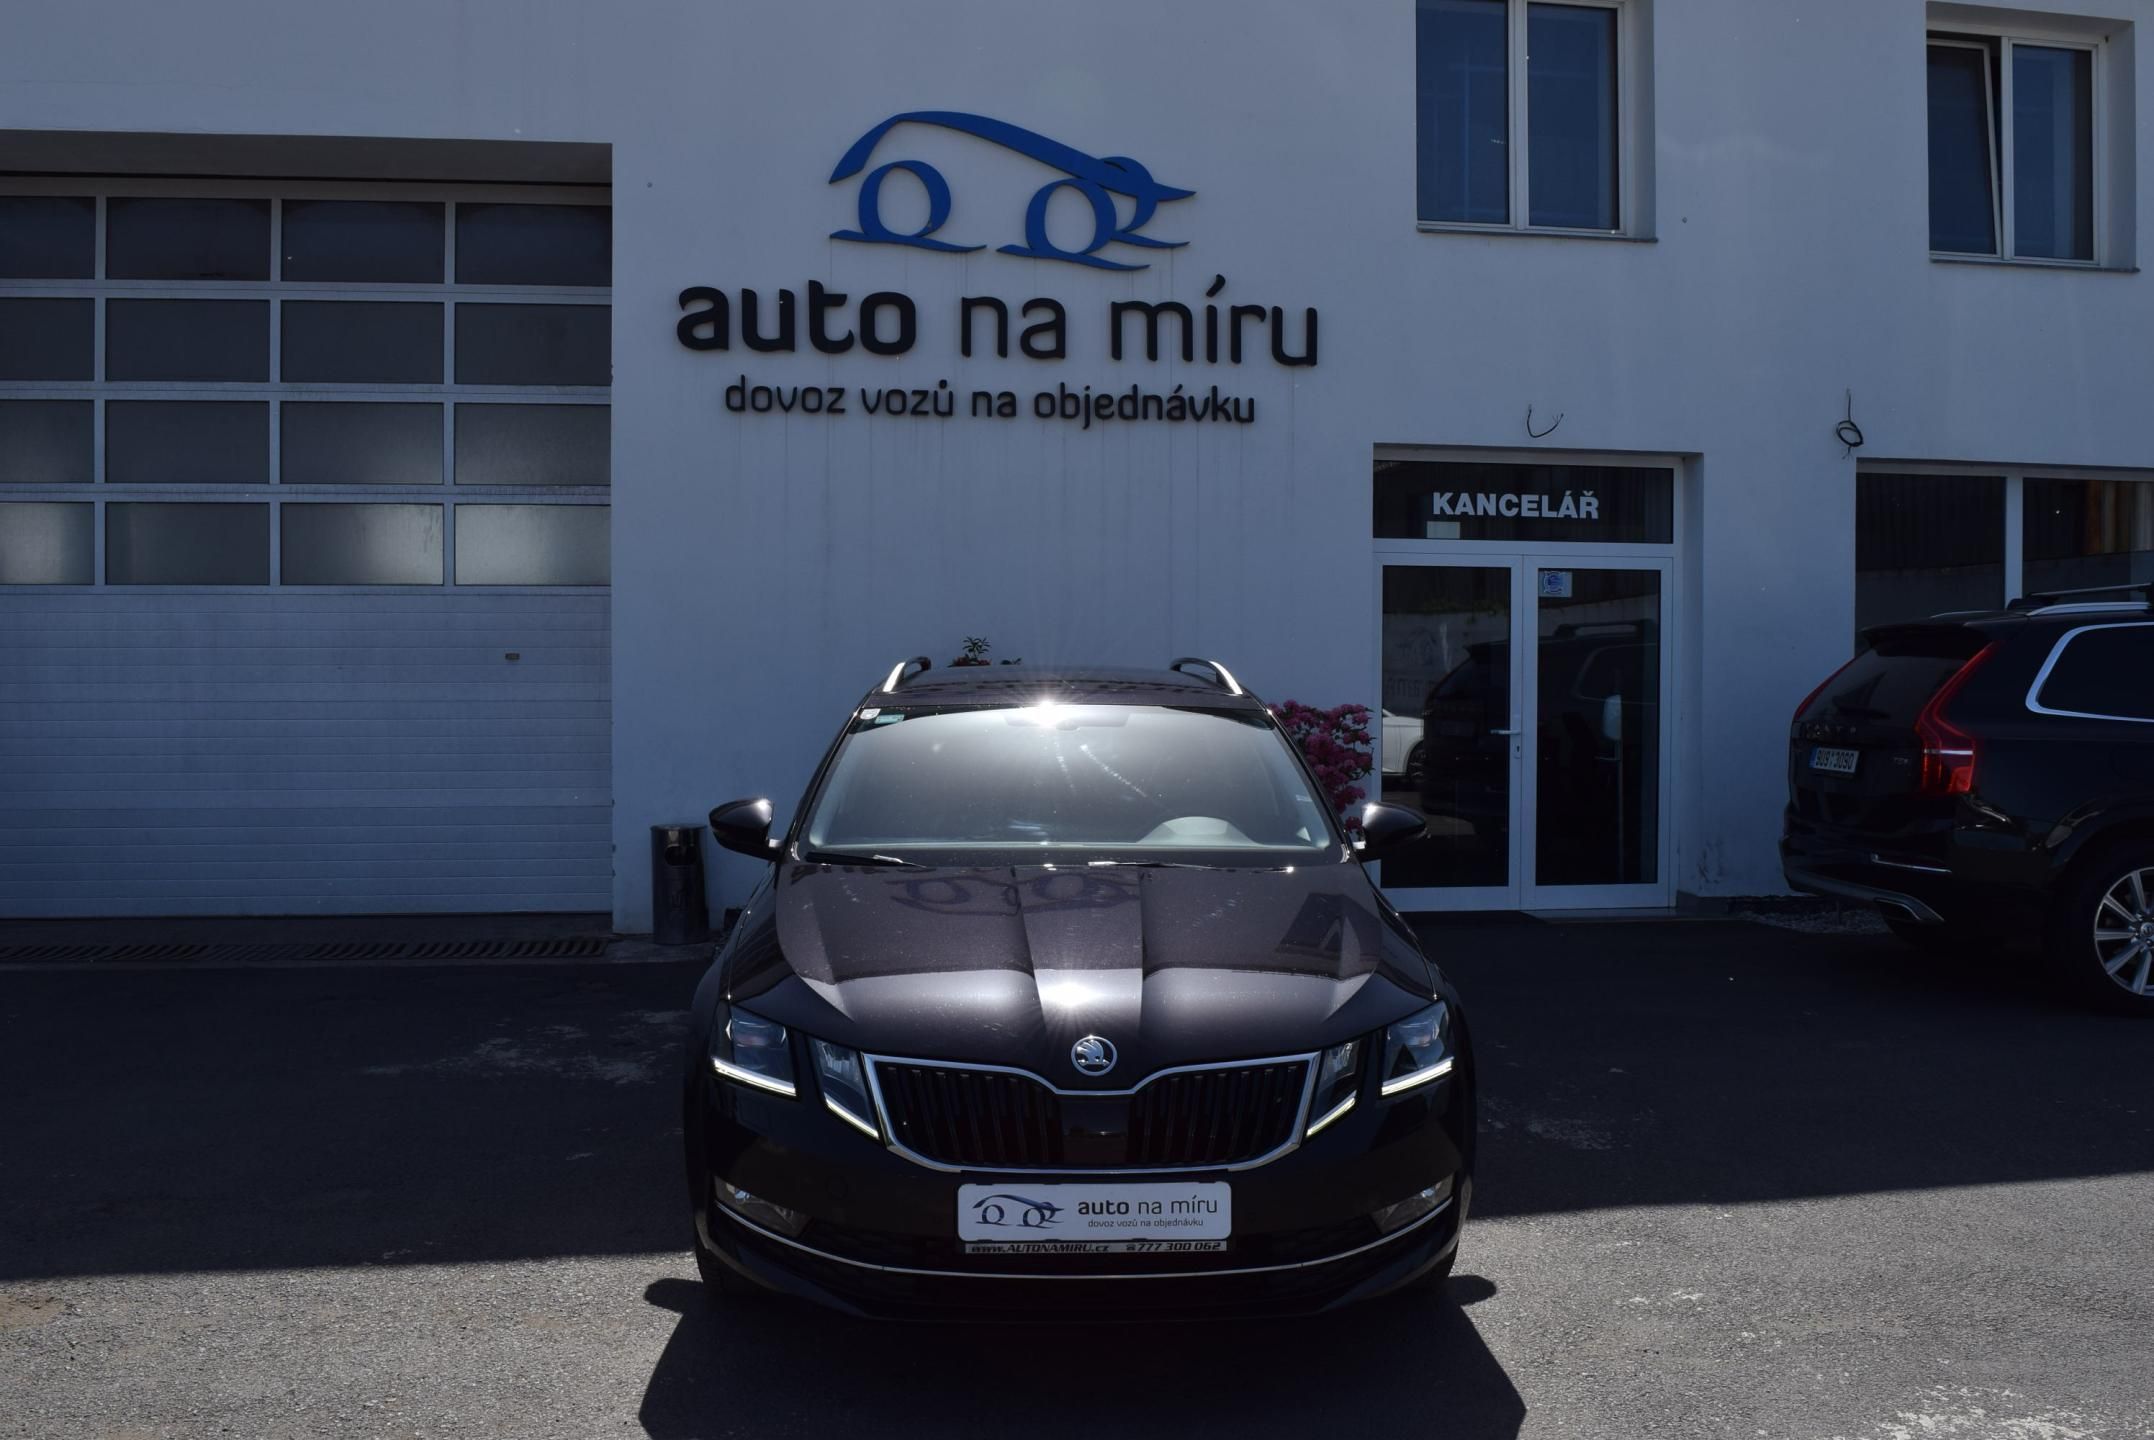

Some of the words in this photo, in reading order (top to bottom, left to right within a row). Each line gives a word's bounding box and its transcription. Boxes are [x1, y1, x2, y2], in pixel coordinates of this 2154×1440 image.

[677, 279, 917, 357] auto
[960, 296, 1067, 361] na
[1108, 273, 1318, 367] míru
[724, 374, 846, 414] dovoz
[861, 379, 954, 418] vozů
[971, 390, 1017, 419] na
[1033, 382, 1255, 430] objednávku
[1432, 490, 1600, 520] KANCELÁŘ
[1078, 1199, 1130, 1215] auto
[1138, 1201, 1162, 1215] na
[1170, 1194, 1218, 1214] míru
[1087, 1219, 1115, 1229] dovoz
[1116, 1218, 1138, 1228] vozů
[1140, 1220, 1152, 1228] na
[1153, 1217, 1204, 1229] objednávku
[1138, 1242, 1162, 1253] 777
[1166, 1242, 1191, 1252] 300
[1194, 1241, 1221, 1252] 062
